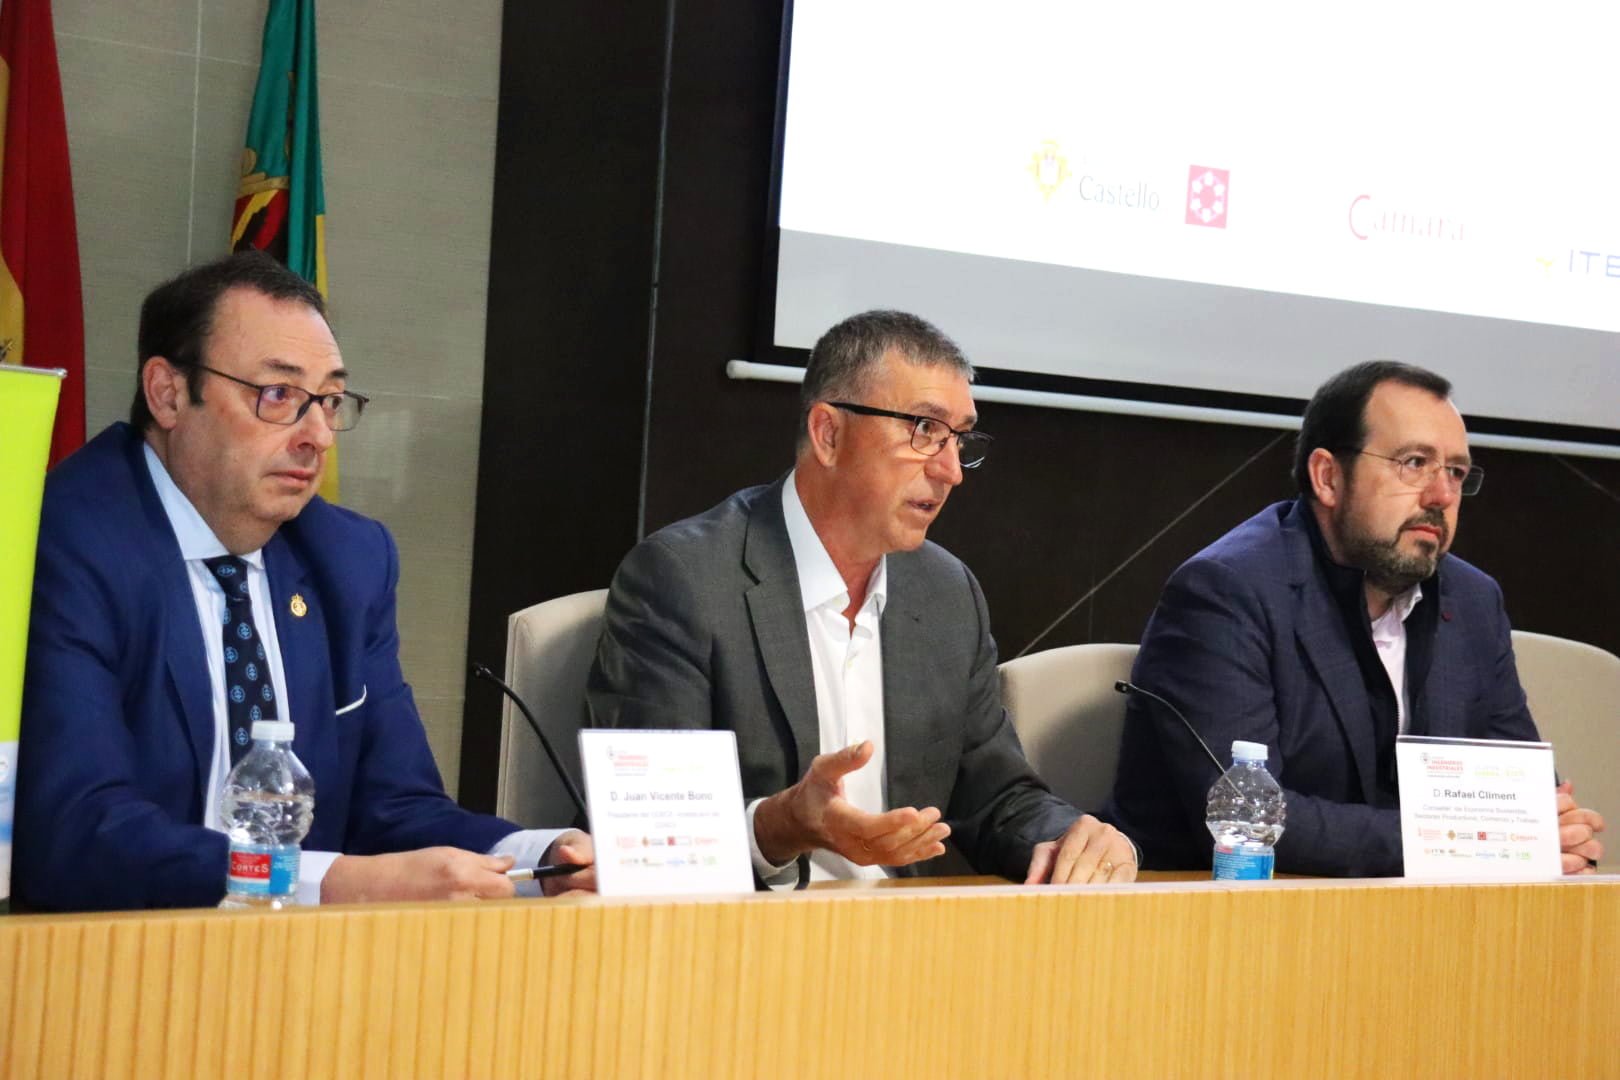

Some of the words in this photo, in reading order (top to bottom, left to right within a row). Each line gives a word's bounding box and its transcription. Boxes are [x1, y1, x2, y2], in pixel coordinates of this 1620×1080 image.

[1569, 249, 1620, 278] ITE
[624, 791, 647, 801] Juan
[650, 791, 685, 801] Vicente
[688, 790, 713, 801] Bono
[1444, 789, 1476, 799] Rafael
[1478, 790, 1517, 801] Climent
